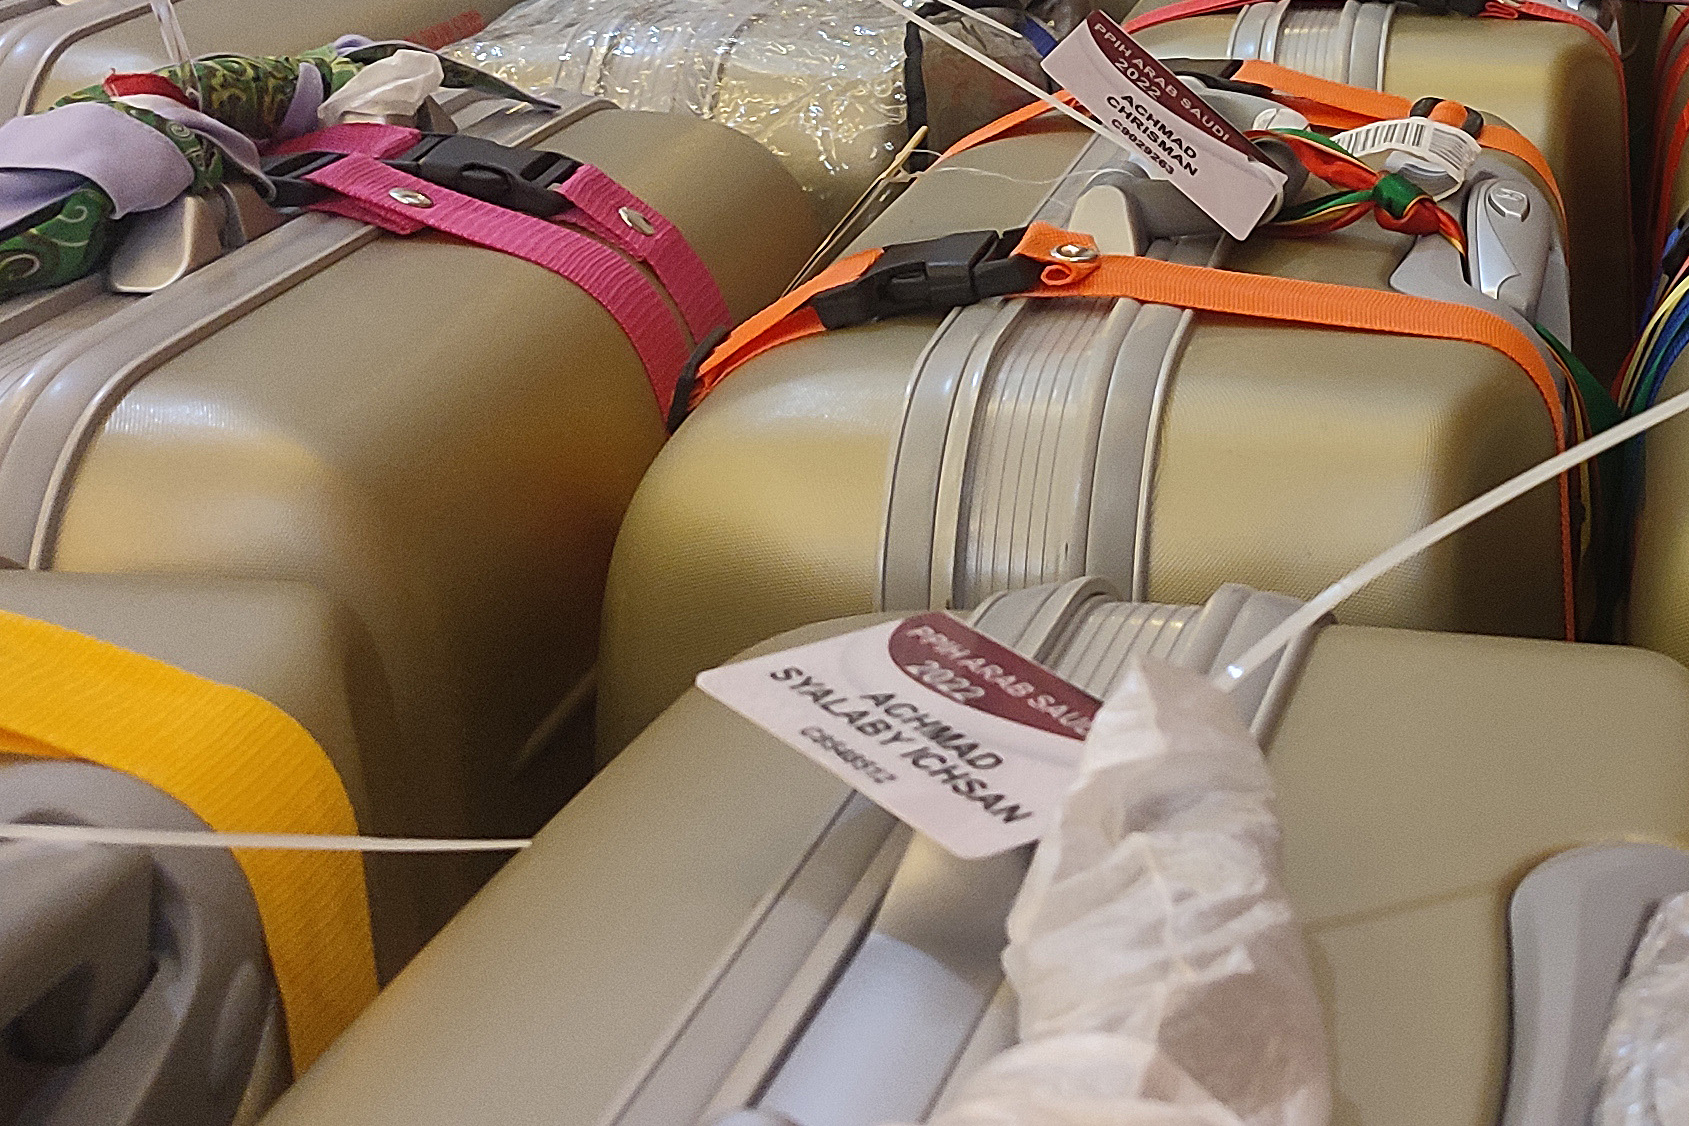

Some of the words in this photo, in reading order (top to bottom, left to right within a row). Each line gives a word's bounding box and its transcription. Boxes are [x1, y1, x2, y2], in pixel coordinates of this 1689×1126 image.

[1092, 23, 1132, 58] PPIH
[1131, 57, 1178, 98] ARAB
[1180, 97, 1231, 142] SAUDI
[1114, 57, 1162, 100] 2022
[1105, 95, 1199, 178] CHRISMAN
[1120, 93, 1199, 160] ACHMAD
[906, 660, 987, 703] 2022
[963, 656, 1033, 698] ARAB
[769, 665, 914, 747] SYALABY
[899, 745, 1035, 825] ICHSAN
[859, 689, 1005, 771] ACHMAD
